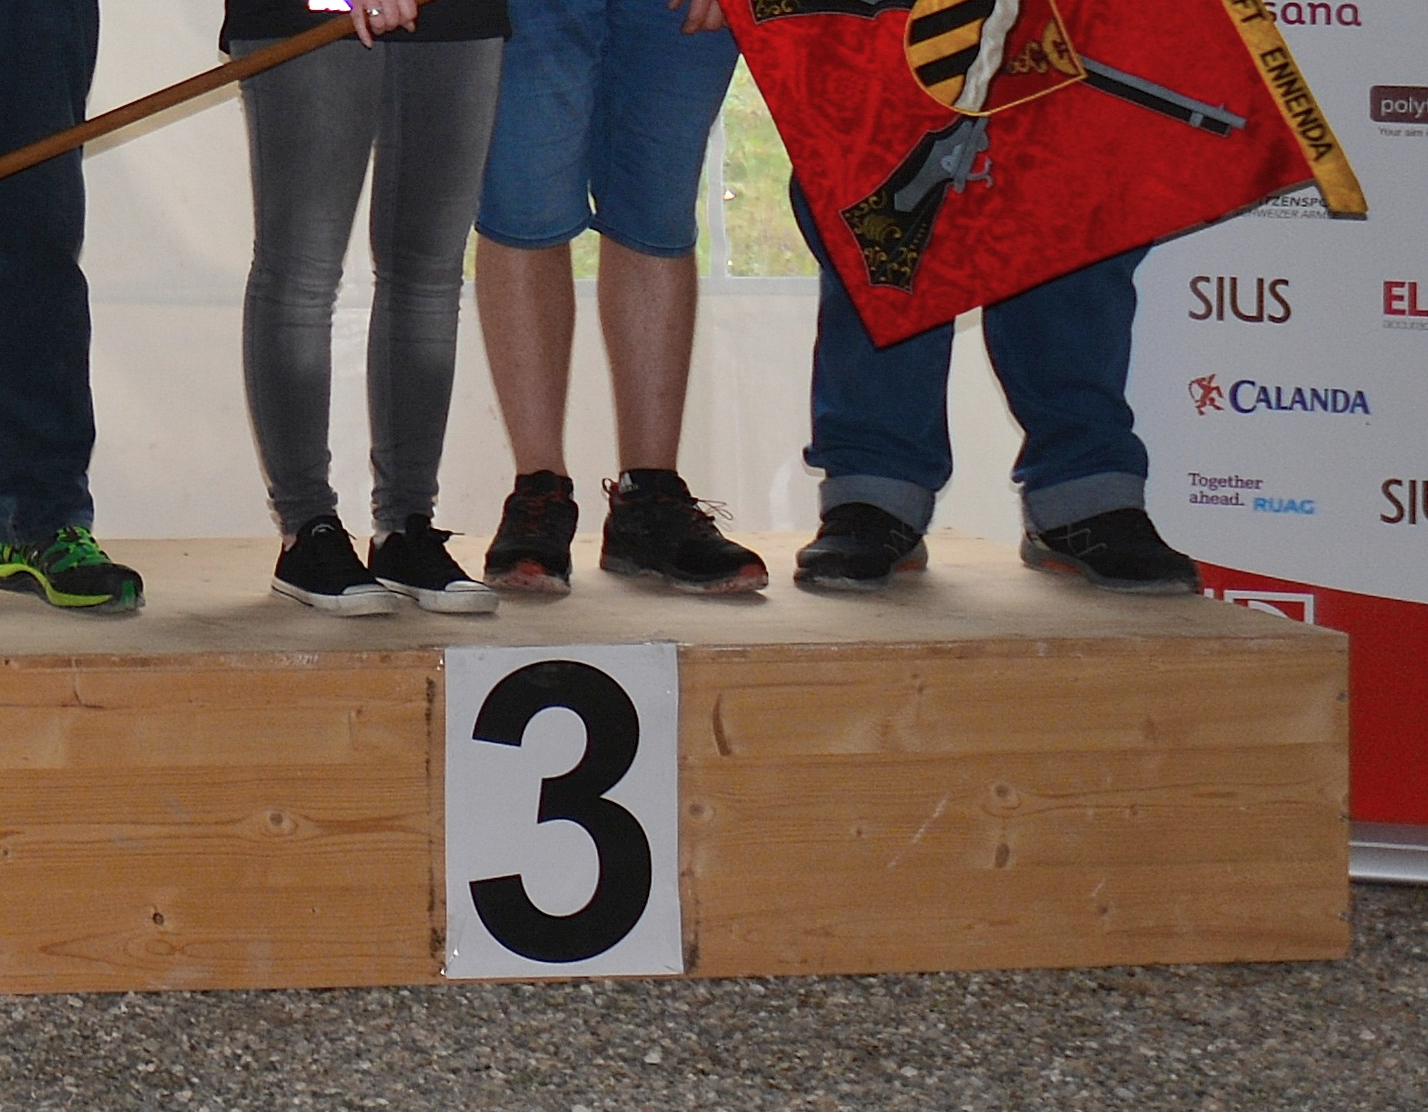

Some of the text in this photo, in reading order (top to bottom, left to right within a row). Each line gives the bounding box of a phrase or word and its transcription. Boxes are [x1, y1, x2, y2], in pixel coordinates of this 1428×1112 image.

[1263, 0, 1363, 27] sana
[1259, 46, 1333, 162] ENNENDA
[1380, 96, 1428, 119] poly
[1188, 275, 1292, 324] SIUS
[1228, 380, 1371, 415] CALANDA
[1188, 472, 1264, 491] Together
[1189, 490, 1245, 506] ahead.
[1253, 497, 1315, 515] RUAG
[1380, 478, 1428, 525] SI
[469, 659, 653, 964] 3
